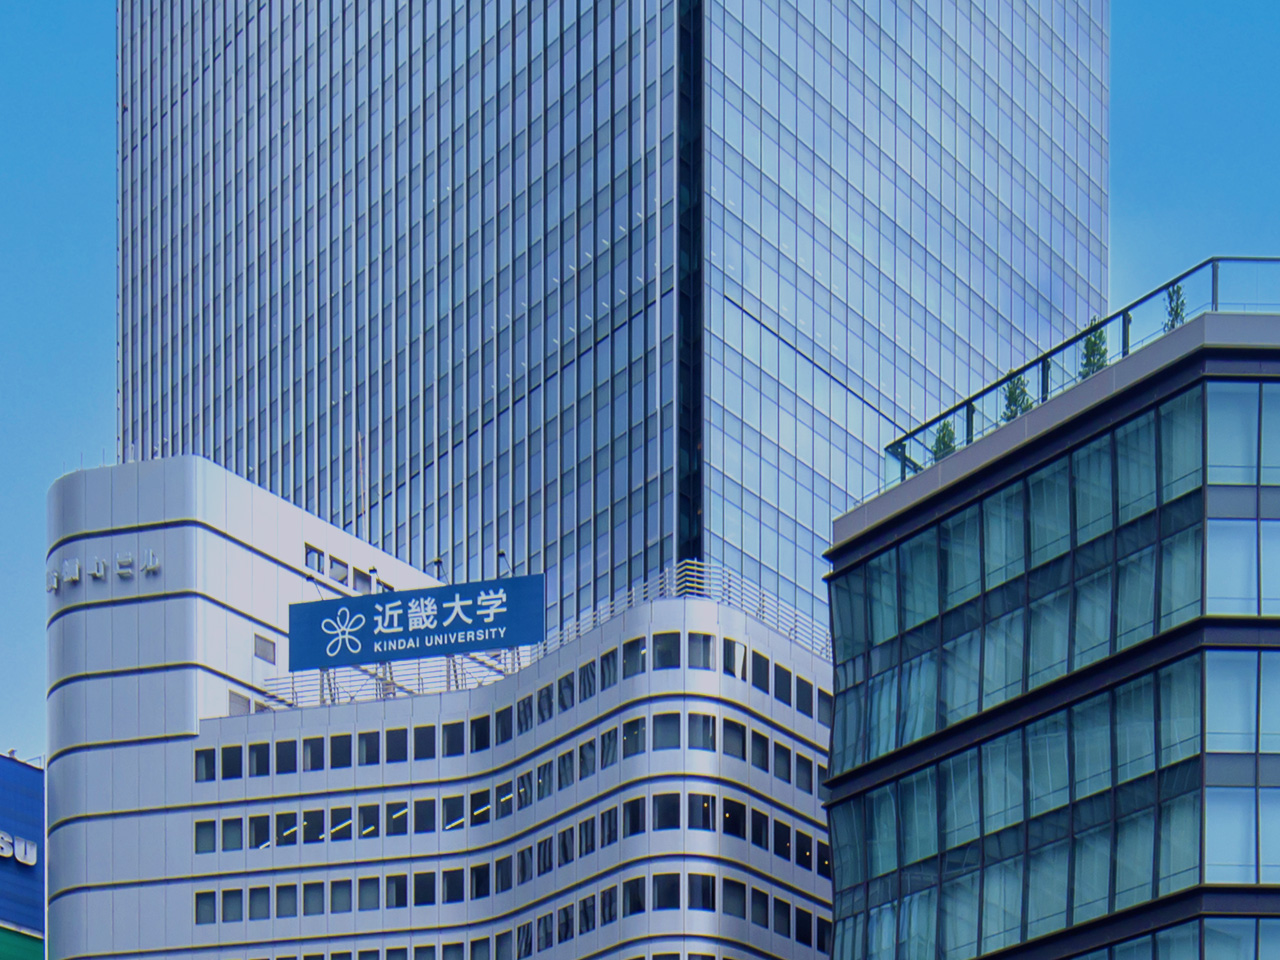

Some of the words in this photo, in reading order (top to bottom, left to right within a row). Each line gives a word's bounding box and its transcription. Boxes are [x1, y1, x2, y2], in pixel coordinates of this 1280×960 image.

[373, 588, 508, 635] 近畿大学
[374, 637, 420, 653] KINDAI
[425, 627, 507, 647] UNIVERSITY
